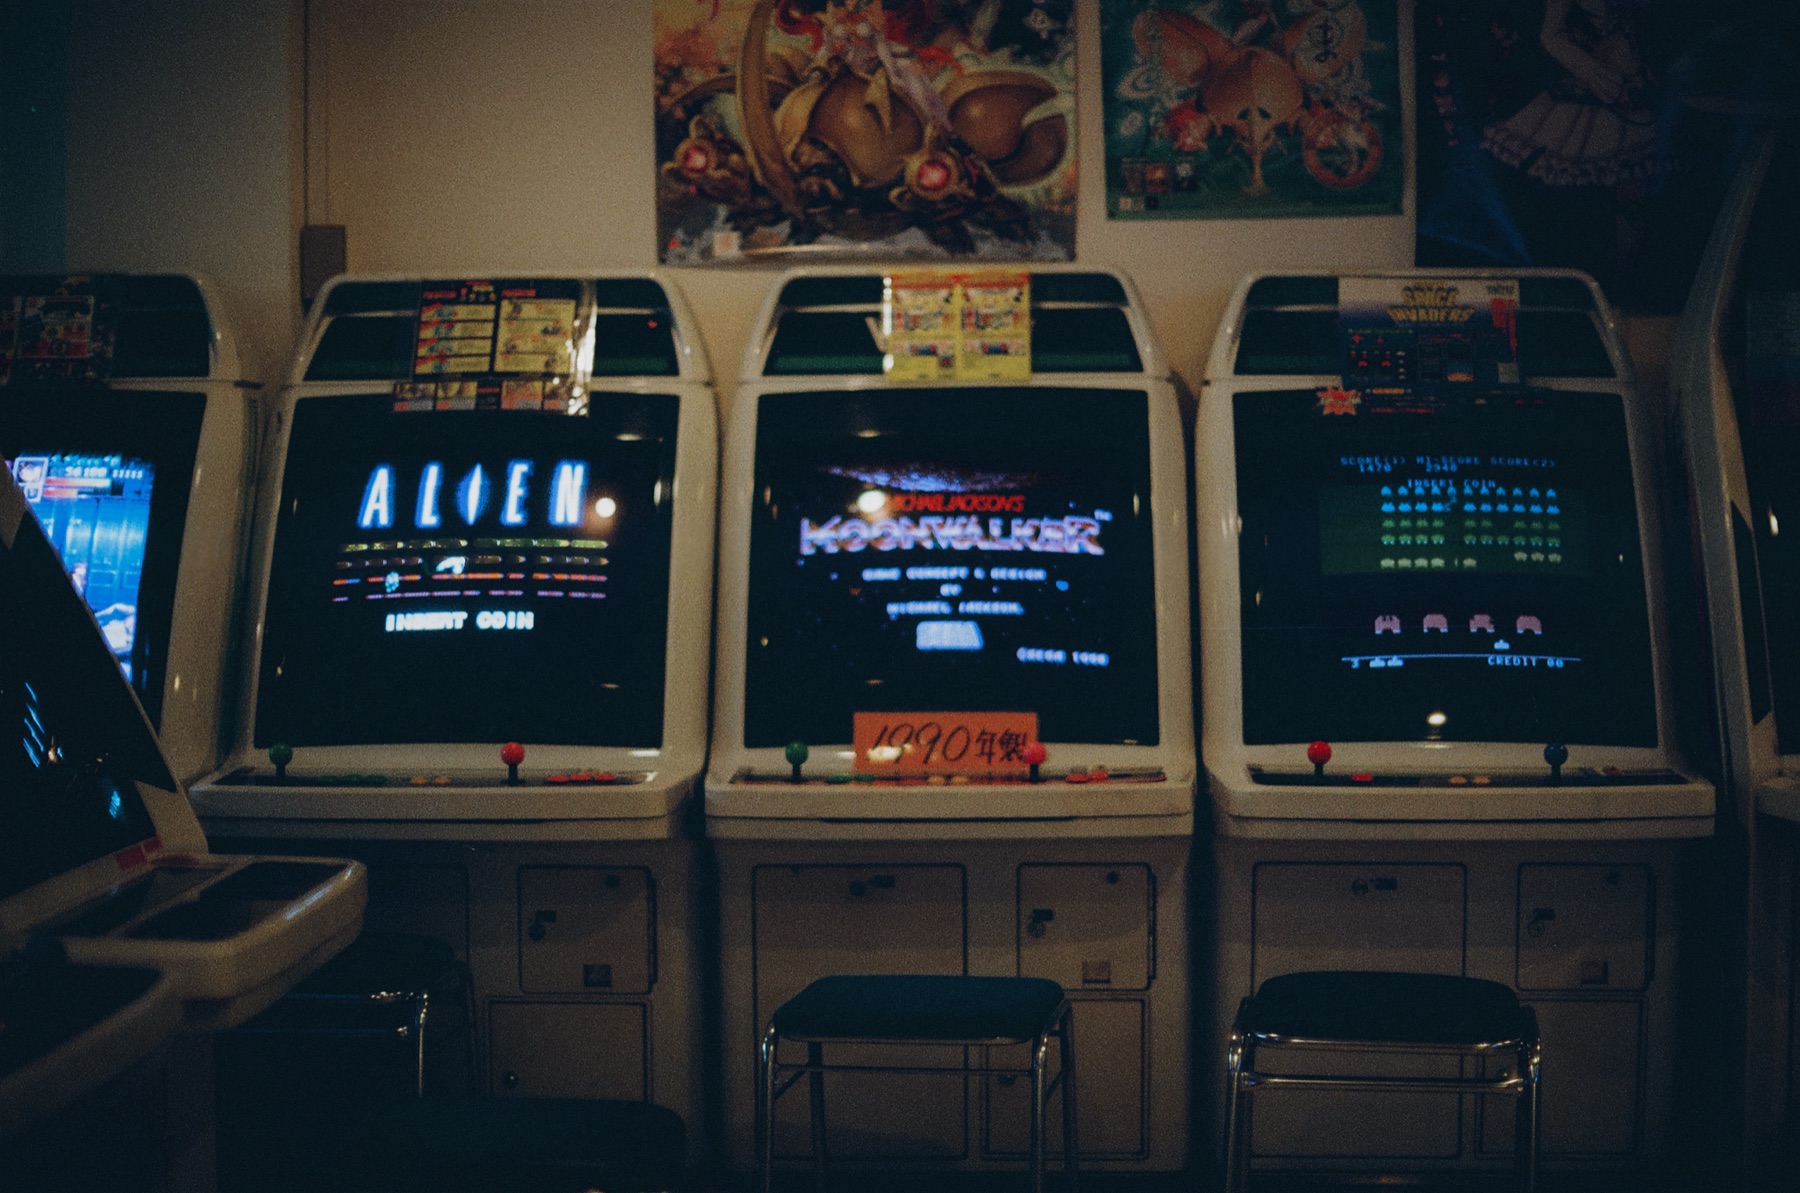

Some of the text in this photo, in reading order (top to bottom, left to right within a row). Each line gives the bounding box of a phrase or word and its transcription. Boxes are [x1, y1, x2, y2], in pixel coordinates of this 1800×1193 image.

[357, 459, 590, 528] ALIEN
[384, 610, 535, 632] INSERT COIN
[1487, 656, 1538, 667] CREDIT
